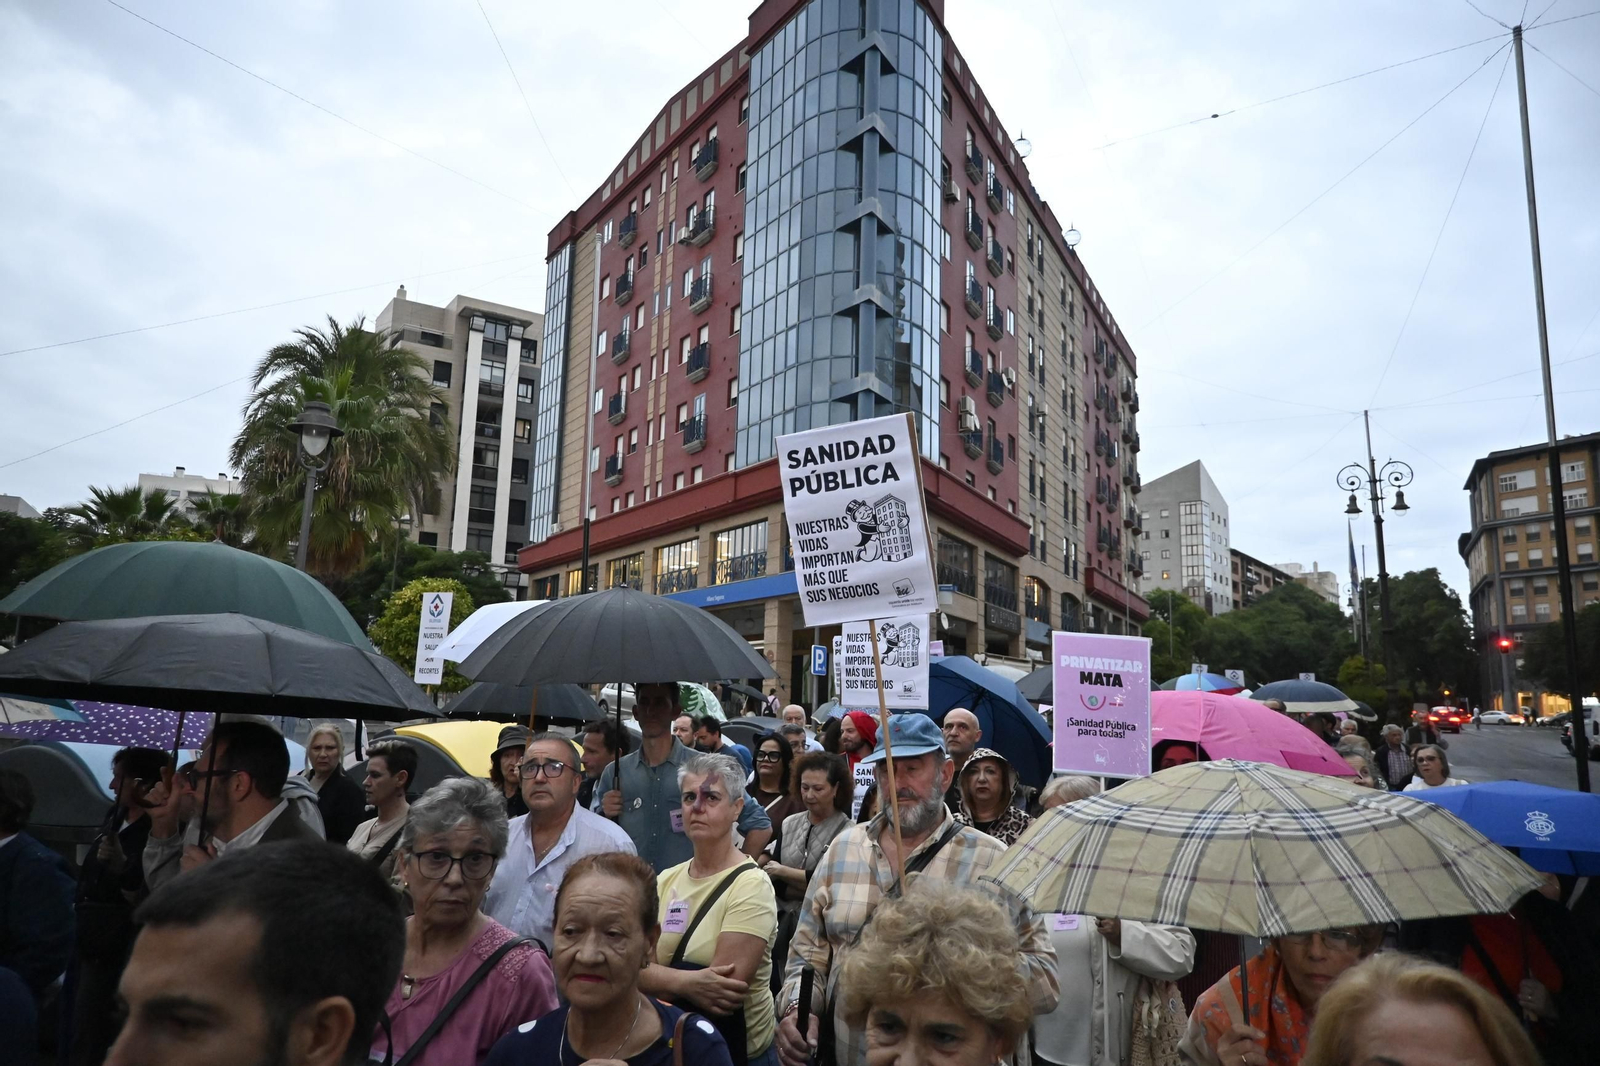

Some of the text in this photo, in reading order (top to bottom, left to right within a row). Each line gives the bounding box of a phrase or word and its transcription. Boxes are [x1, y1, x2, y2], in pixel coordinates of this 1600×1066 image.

[787, 434, 896, 469] SANIDAD
[789, 462, 900, 497] PÚBLICA
[795, 516, 849, 536] NUESTRAS
[798, 537, 829, 553] VIDAS
[801, 550, 854, 570] IMPORTAN
[803, 569, 849, 587] MÁS QUE
[806, 583, 880, 603] SUS NEGOCIOS
[847, 633, 881, 642] NUESTRS
[846, 644, 865, 654] VIDAS
[815, 649, 825, 671] P
[845, 656, 875, 665] IMPORTA
[1060, 655, 1143, 673] PRIVATIZAR
[845, 666, 860, 677] MÁS
[861, 668, 875, 678] QUE
[1080, 671, 1123, 688] MATA
[845, 679, 893, 689] SUS NEGOIOS
[1066, 717, 1136, 731] ¡Sanidad Pública
[1078, 728, 1125, 739] para todas!
